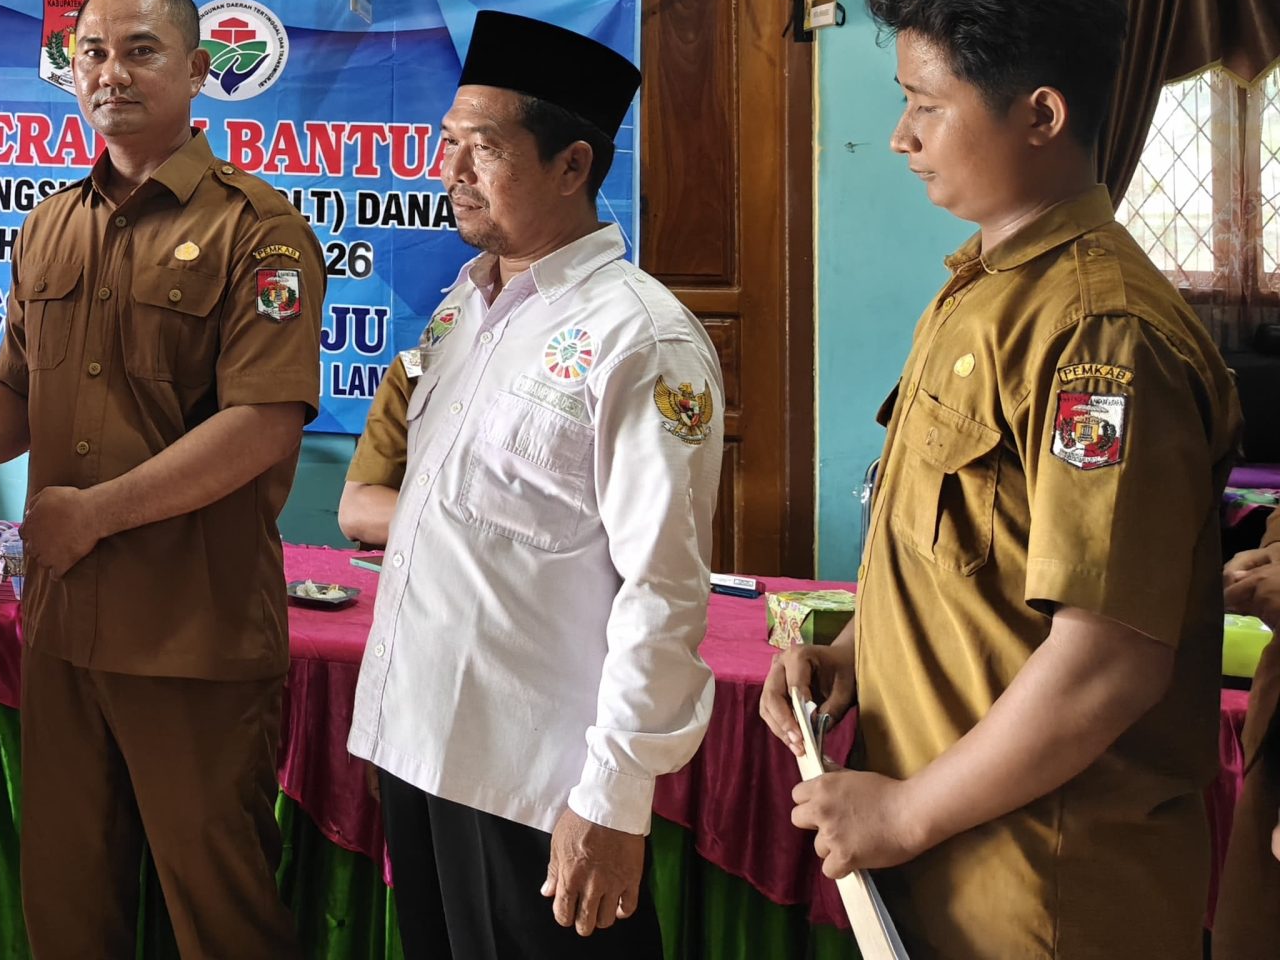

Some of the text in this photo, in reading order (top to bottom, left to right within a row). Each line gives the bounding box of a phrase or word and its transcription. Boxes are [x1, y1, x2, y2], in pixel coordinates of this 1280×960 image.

[226, 121, 447, 178] BANTU
[358, 192, 458, 228] DANA
[258, 246, 297, 256] PEMKAB
[324, 241, 372, 278] 26
[320, 307, 388, 353] JU
[1063, 365, 1126, 382] PEMKAB
